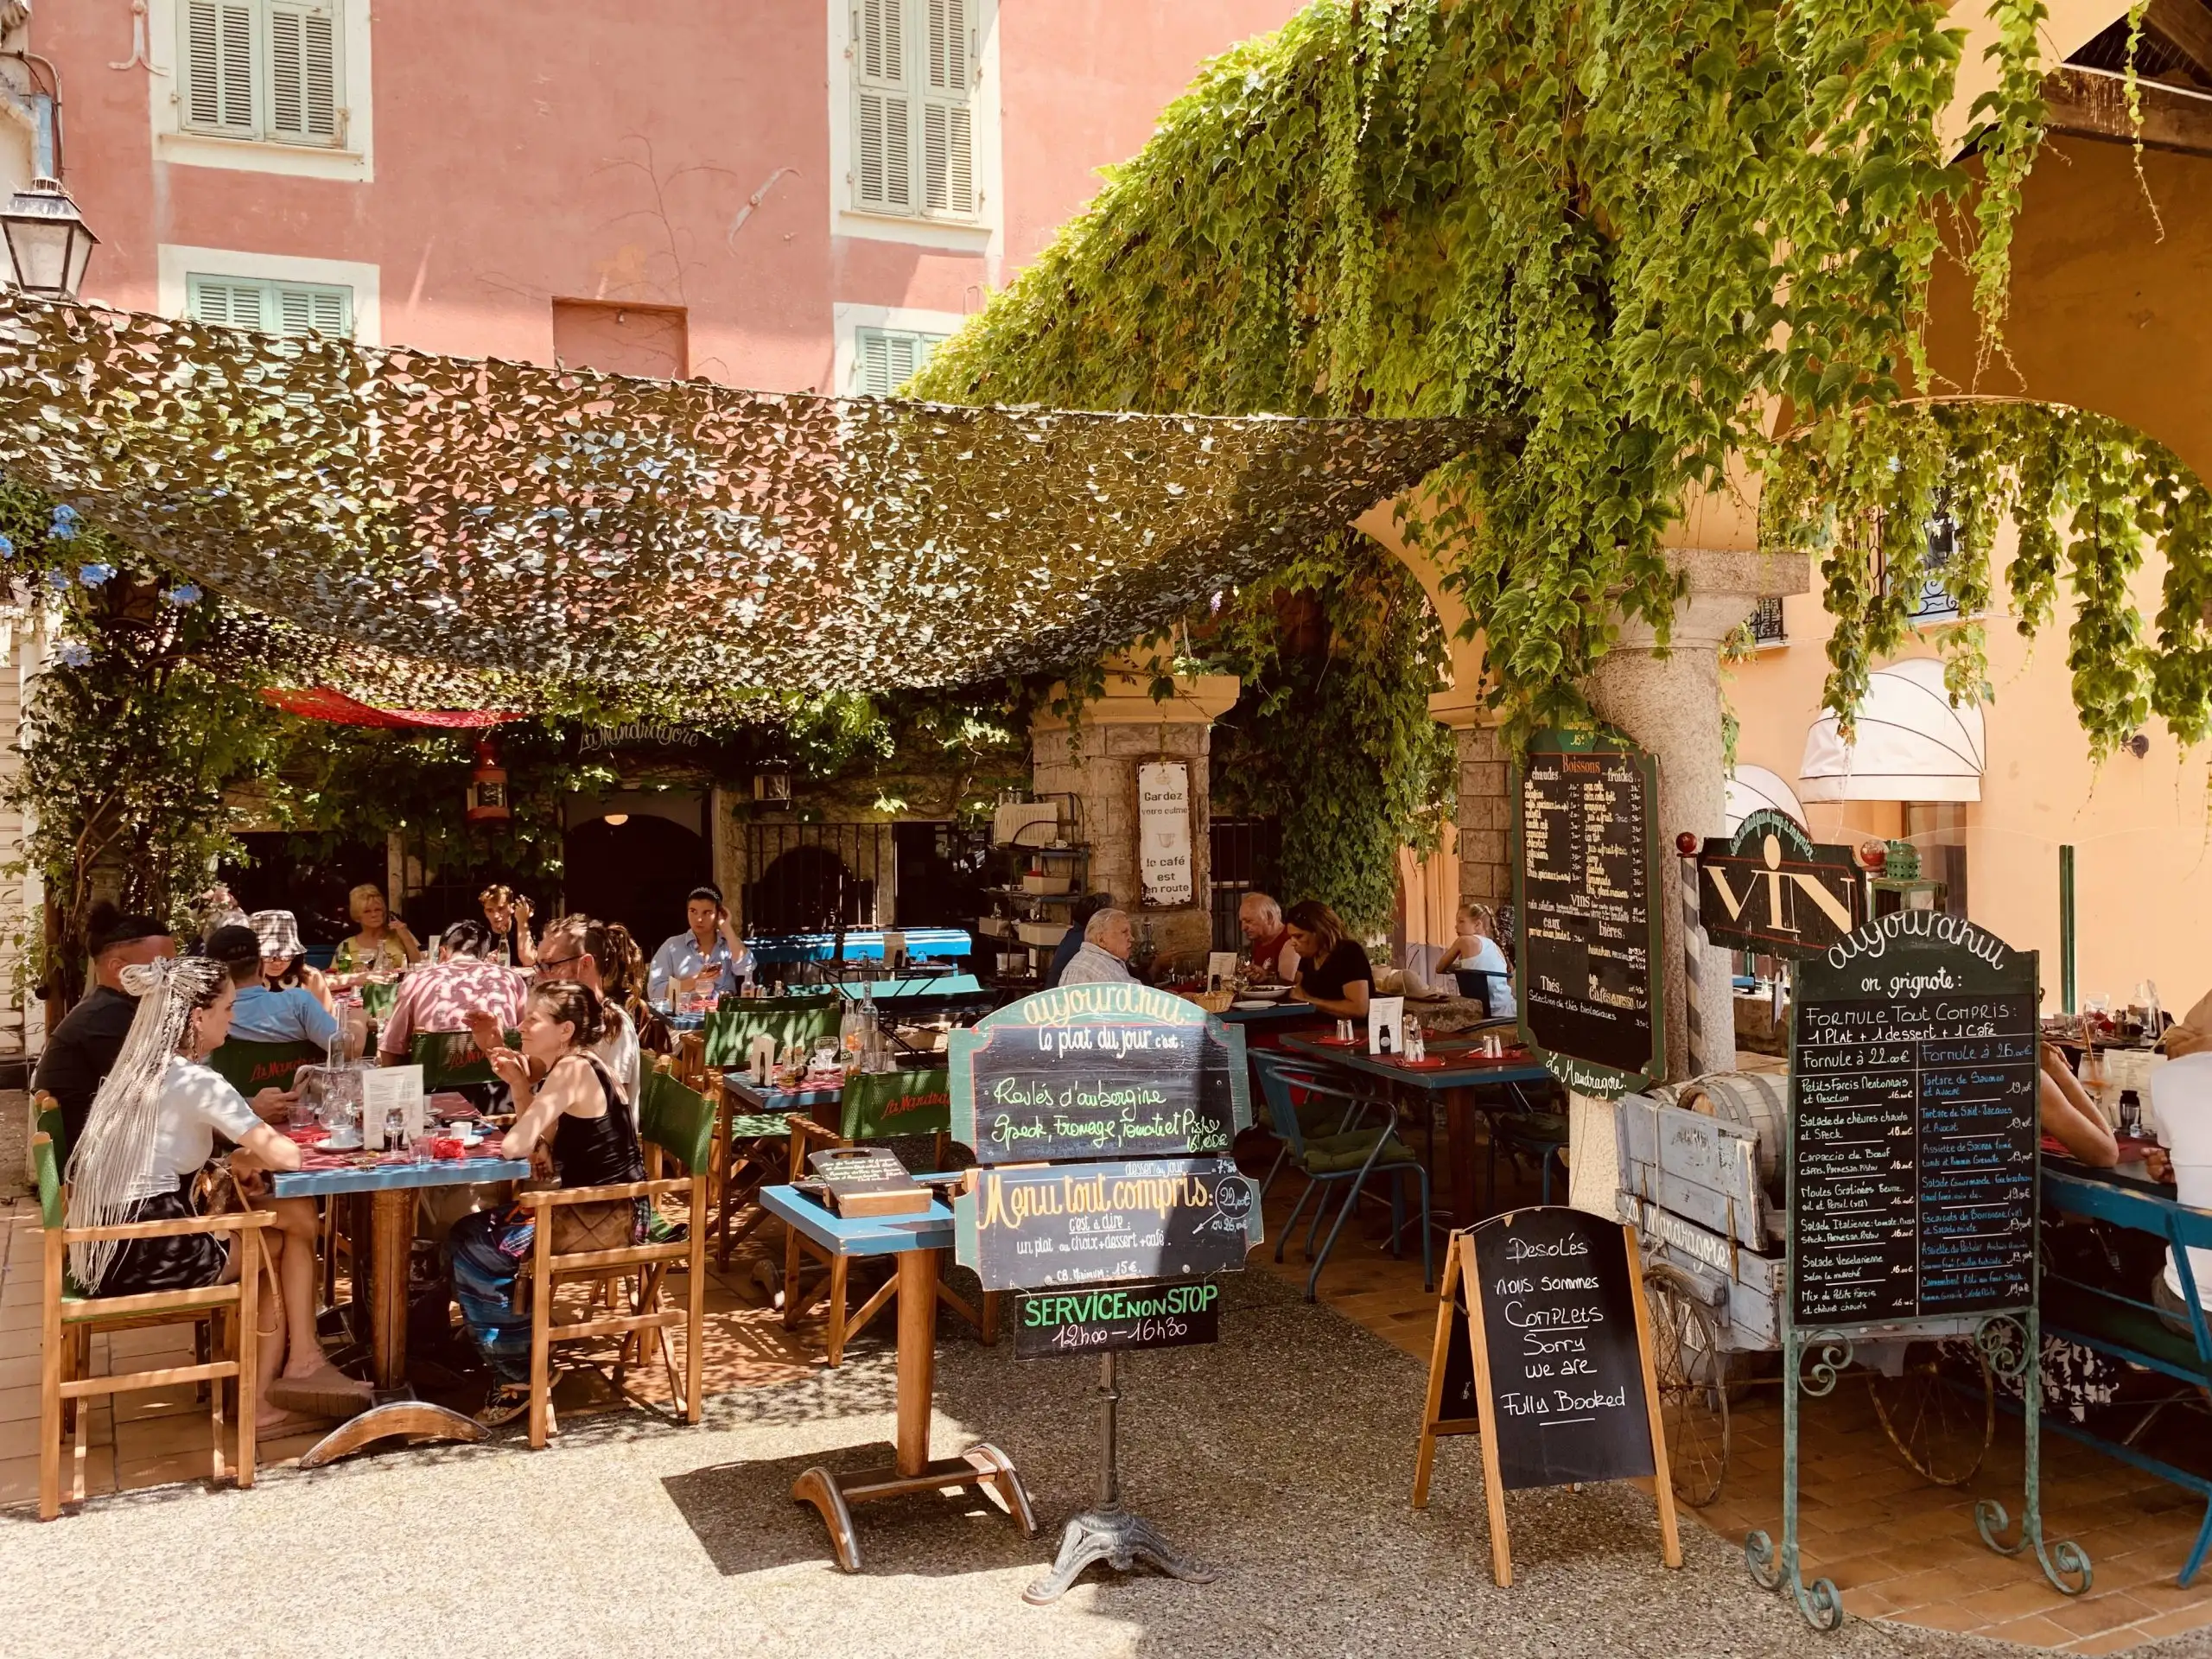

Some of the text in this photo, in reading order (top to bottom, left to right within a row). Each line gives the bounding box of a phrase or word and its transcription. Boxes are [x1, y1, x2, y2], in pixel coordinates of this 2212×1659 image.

[1562, 754, 1600, 773] Boissons
[1144, 791, 1183, 802] Gardez
[1160, 855, 1185, 867] café
[1157, 873, 1175, 881] est
[1702, 834, 1855, 935] VIN
[1160, 883, 1189, 894] route
[1861, 976, 1881, 992] on
[1039, 1027, 1052, 1052] le
[1058, 1026, 1093, 1058] plat
[1097, 1027, 1119, 1050] du
[1116, 1029, 1152, 1058] jour
[1808, 1029, 1820, 1044] 1
[1860, 1033, 1868, 1042] +
[1872, 1028, 1882, 1040] 1
[1885, 1024, 1936, 1041] dessert
[1951, 1025, 1962, 1037] 1
[1967, 1022, 1997, 1037] Café
[1856, 1051, 1864, 1065] à
[1980, 1044, 1989, 1058] à
[1802, 1078, 1831, 1092] Petits
[1832, 1077, 1859, 1090] Farcis
[1802, 1094, 1814, 1104] et
[1165, 1112, 1181, 1136] et
[976, 1174, 1063, 1230] Menu
[1065, 1173, 1111, 1213] tout
[1069, 1217, 1090, 1232] c'est
[1017, 1240, 1033, 1255] un
[1035, 1236, 1054, 1258] plat
[1059, 1243, 1071, 1252] au
[1496, 1275, 1599, 1296] nous sommes
[1802, 1289, 1818, 1302] Mix
[1024, 1284, 1218, 1328] SERVICE NON STOP
[1128, 1319, 1188, 1343] 16h30
[1523, 1333, 1586, 1357] Sorry
[1525, 1357, 1598, 1379] we are
[1500, 1386, 1625, 1417] Fully Booked
